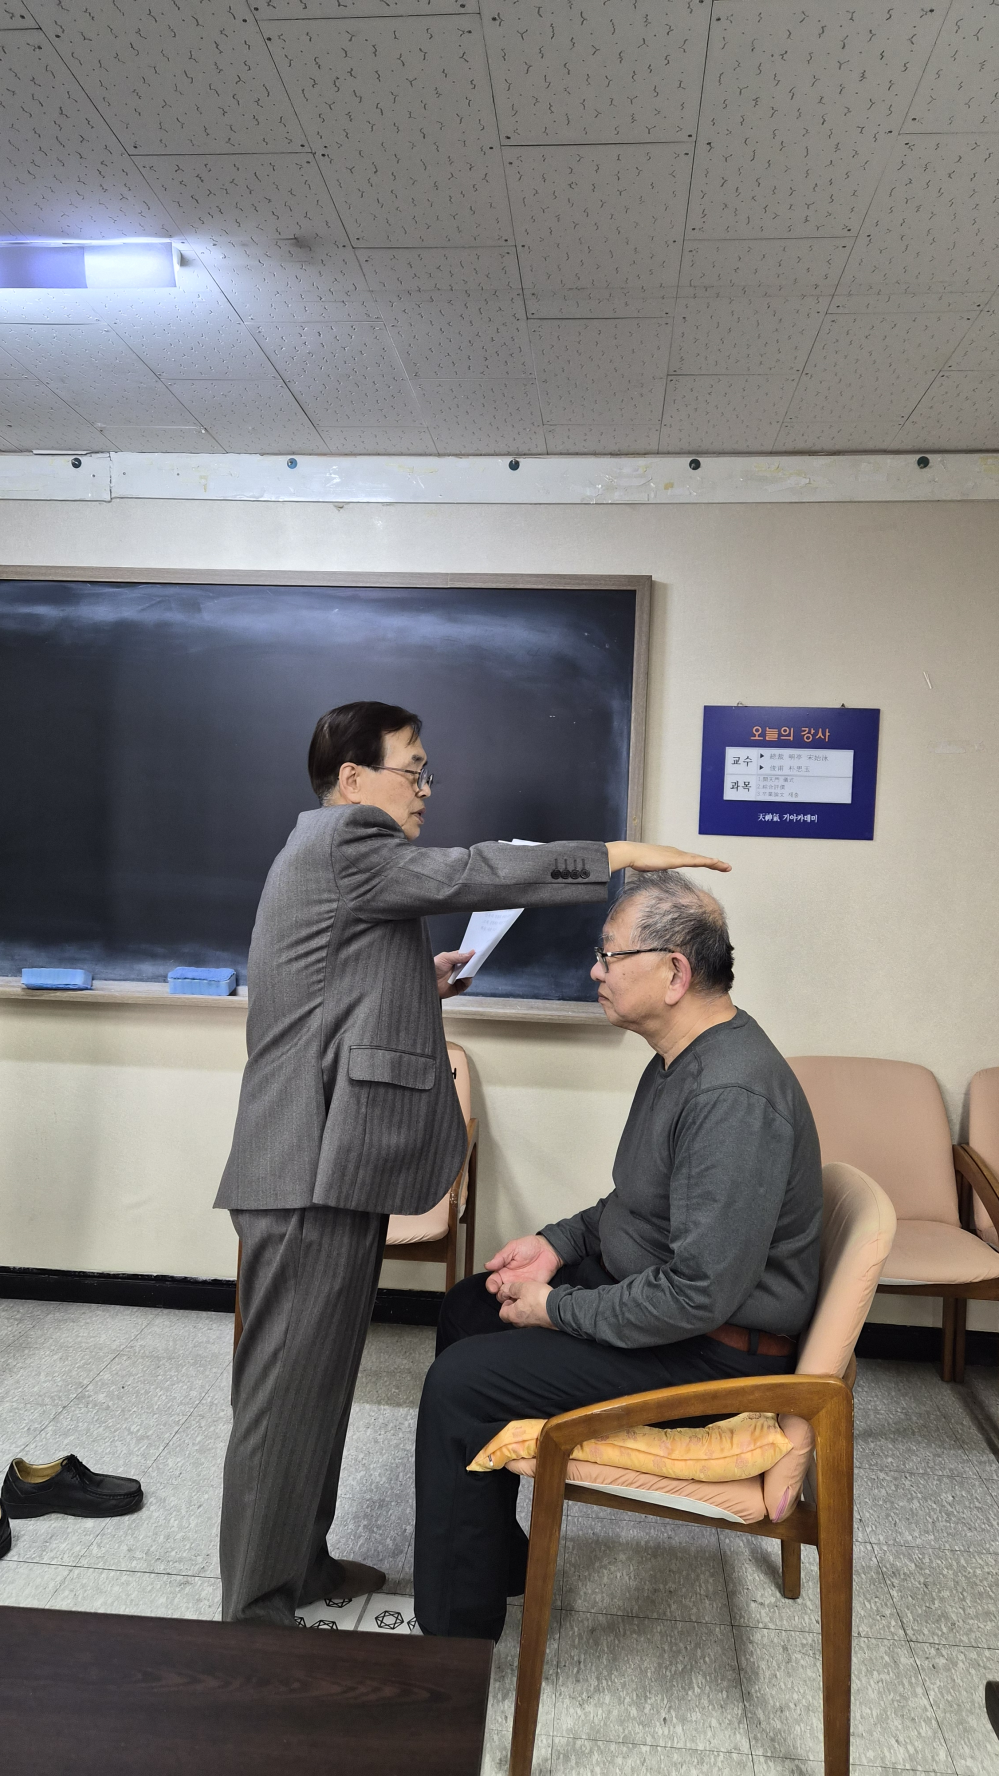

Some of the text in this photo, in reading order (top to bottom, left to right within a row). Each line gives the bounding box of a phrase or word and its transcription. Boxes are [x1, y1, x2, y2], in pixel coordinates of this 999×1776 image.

[750, 726, 831, 743] 오늘의 강사
[731, 755, 753, 767] 교수
[730, 780, 752, 792] 과목
[782, 813, 818, 823] 기아카데미
